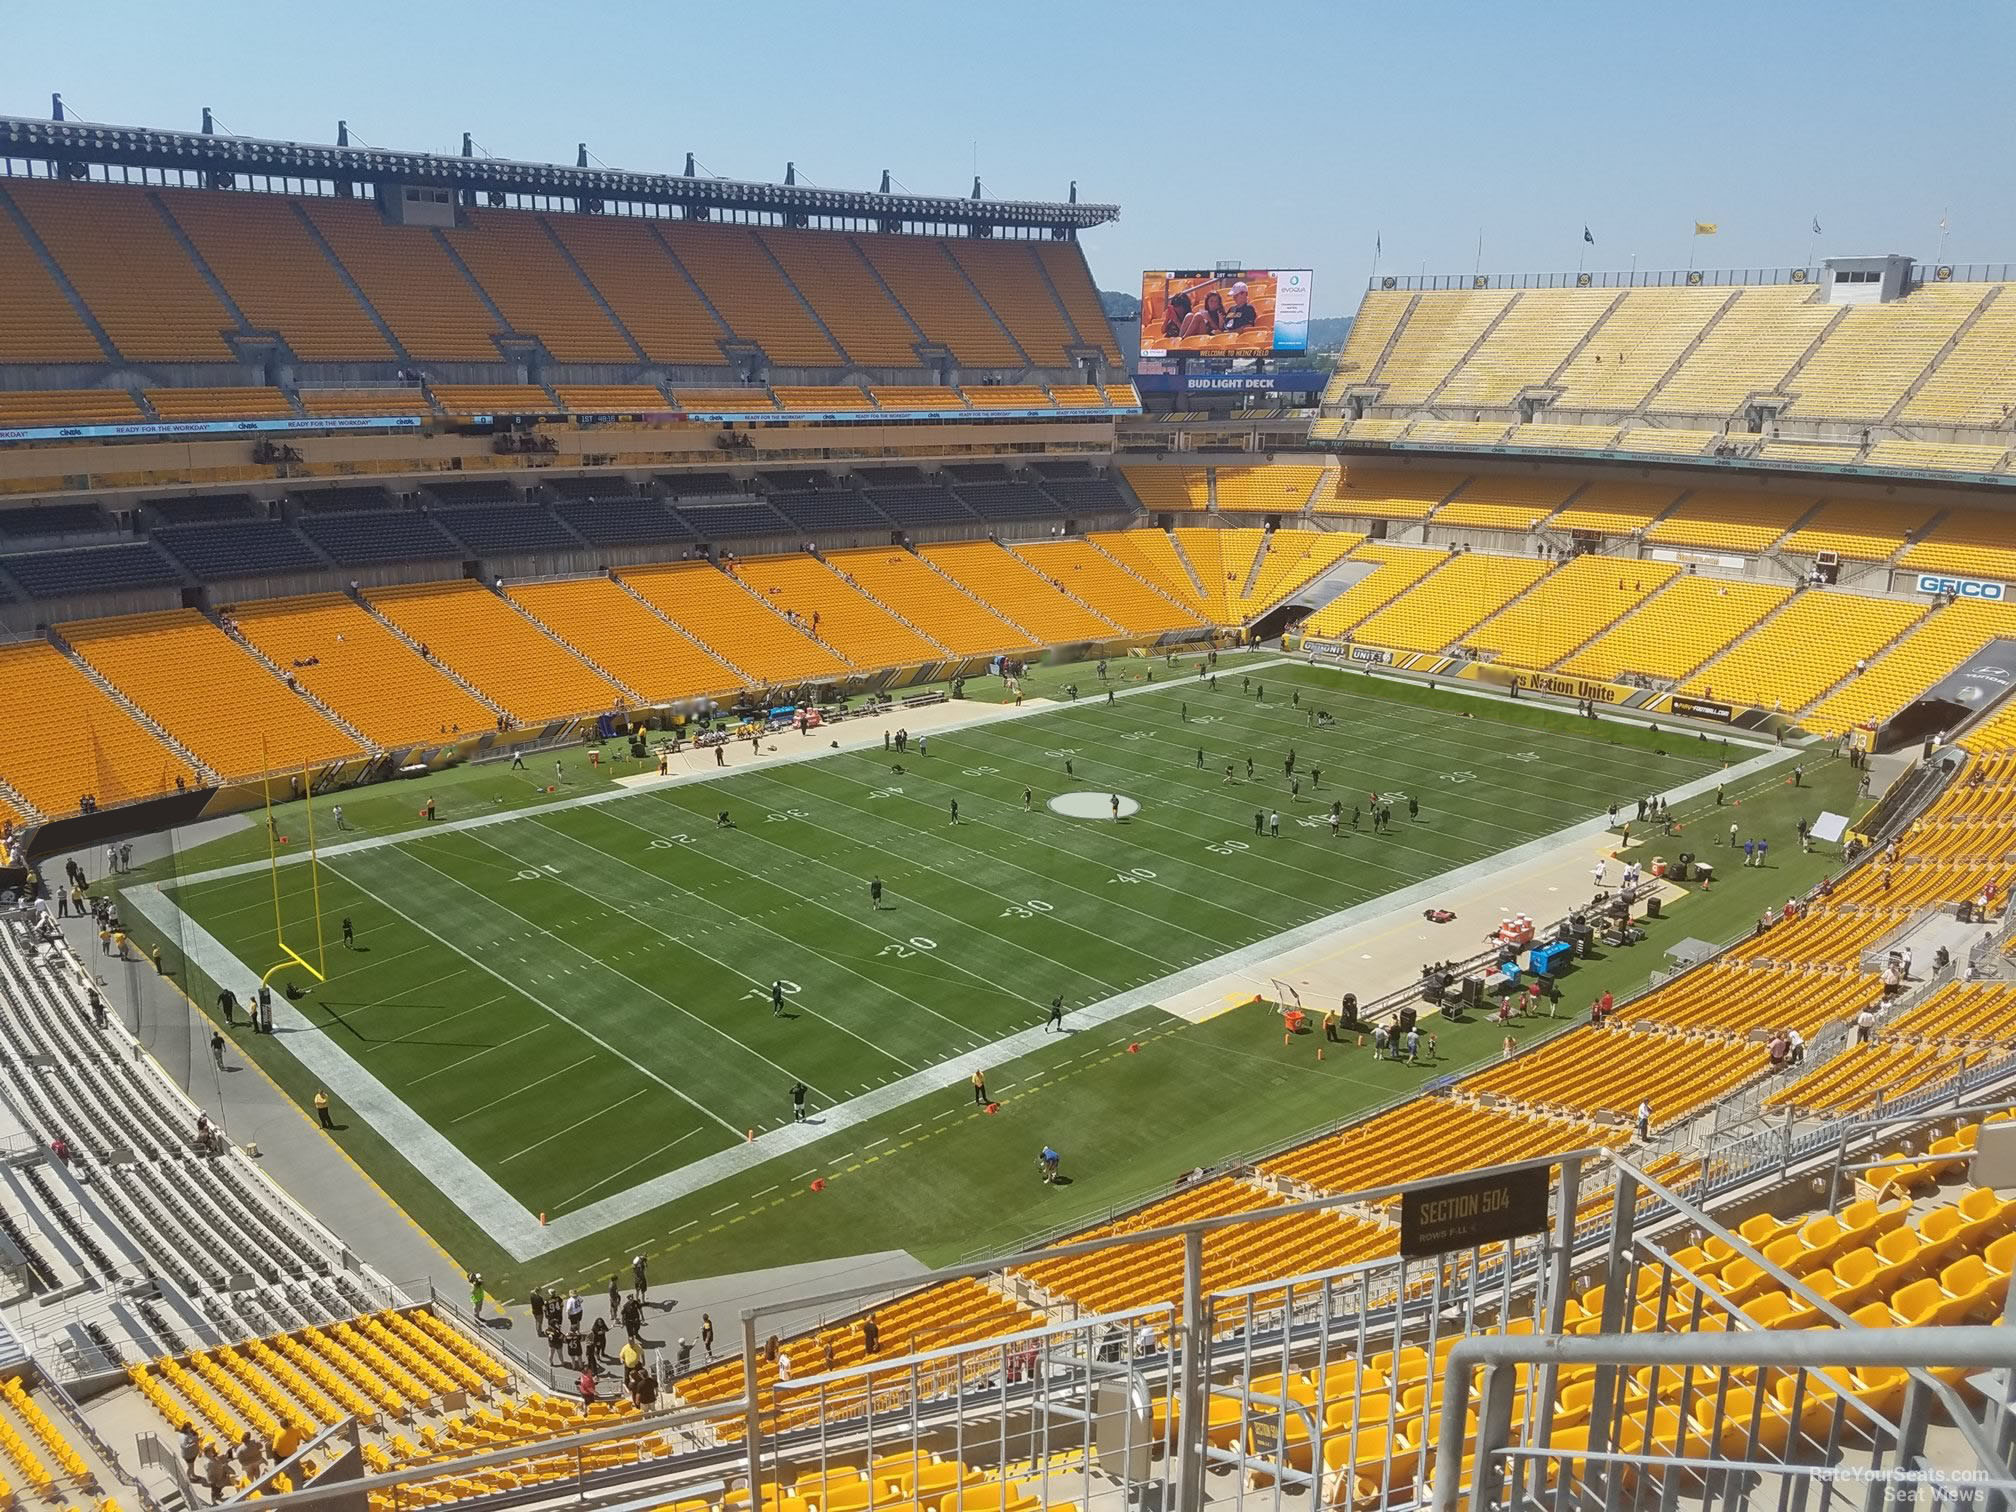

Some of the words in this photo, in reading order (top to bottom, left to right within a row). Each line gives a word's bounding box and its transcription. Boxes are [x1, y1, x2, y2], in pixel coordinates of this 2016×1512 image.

[1188, 379, 1211, 388] BUD
[1212, 379, 1242, 388] LIGHT
[1245, 379, 1275, 388] DECK
[173, 424, 208, 432] WORKDAY
[339, 419, 369, 427] WORKDAY
[1920, 576, 2001, 599] GEICO
[1578, 681, 1615, 702] Unite
[1205, 839, 1250, 855] 50
[1116, 867, 1158, 884] 40
[1005, 900, 1054, 919] 30
[884, 937, 938, 958] 20
[1420, 1193, 1479, 1225] SECTION
[1482, 1187, 1510, 1213] 504
[1419, 1229, 1448, 1242] ROWS
